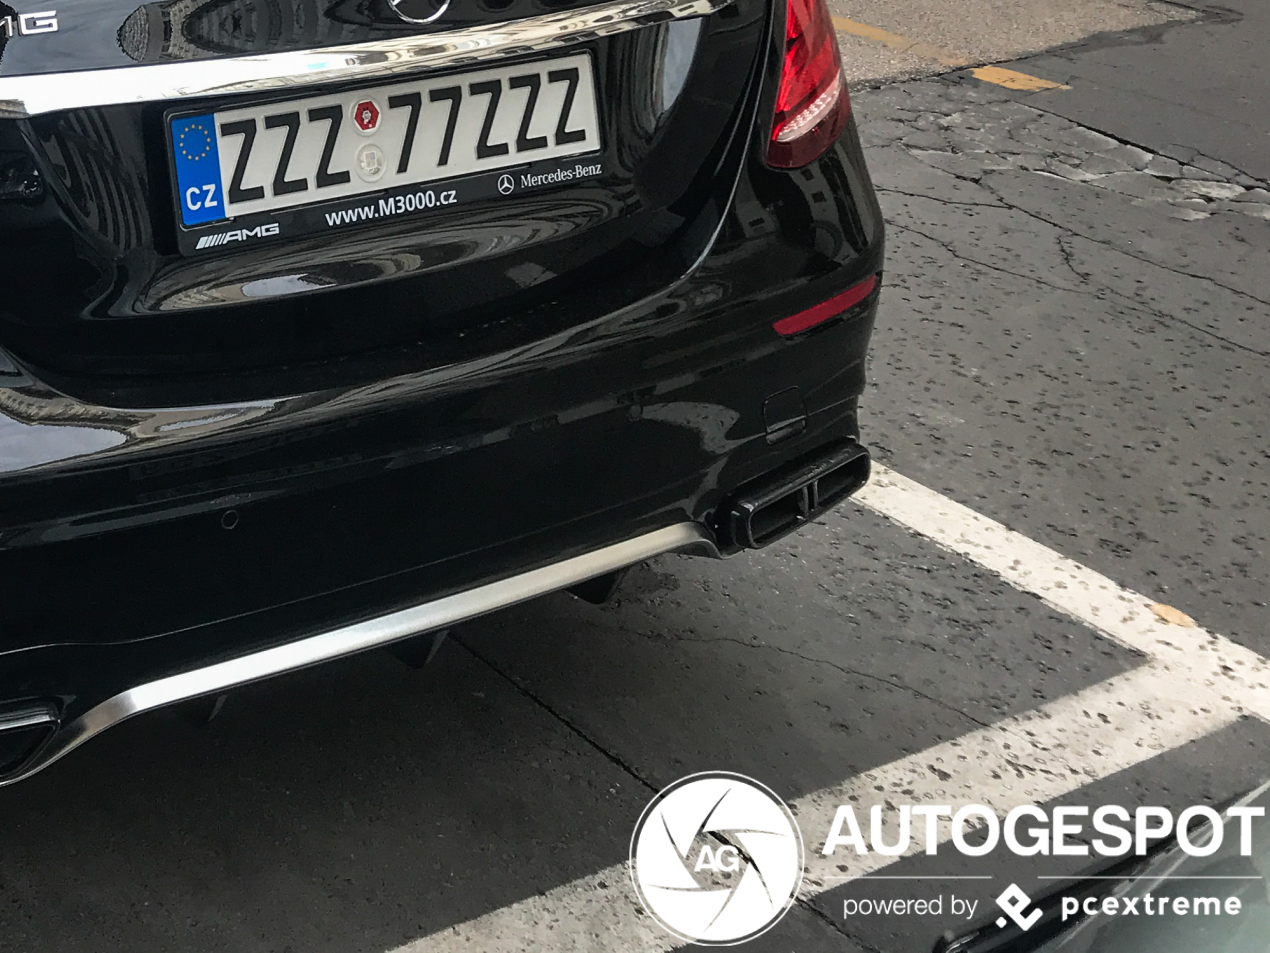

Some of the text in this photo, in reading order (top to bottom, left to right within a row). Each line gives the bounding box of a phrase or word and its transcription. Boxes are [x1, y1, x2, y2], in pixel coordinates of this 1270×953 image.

[220, 67, 587, 205] ZZZ 77ZZZ
[520, 164, 603, 189] Mercedes-Benz
[185, 183, 218, 211] CZ
[325, 188, 458, 227] www.M3000.cz
[224, 223, 280, 245] AMG
